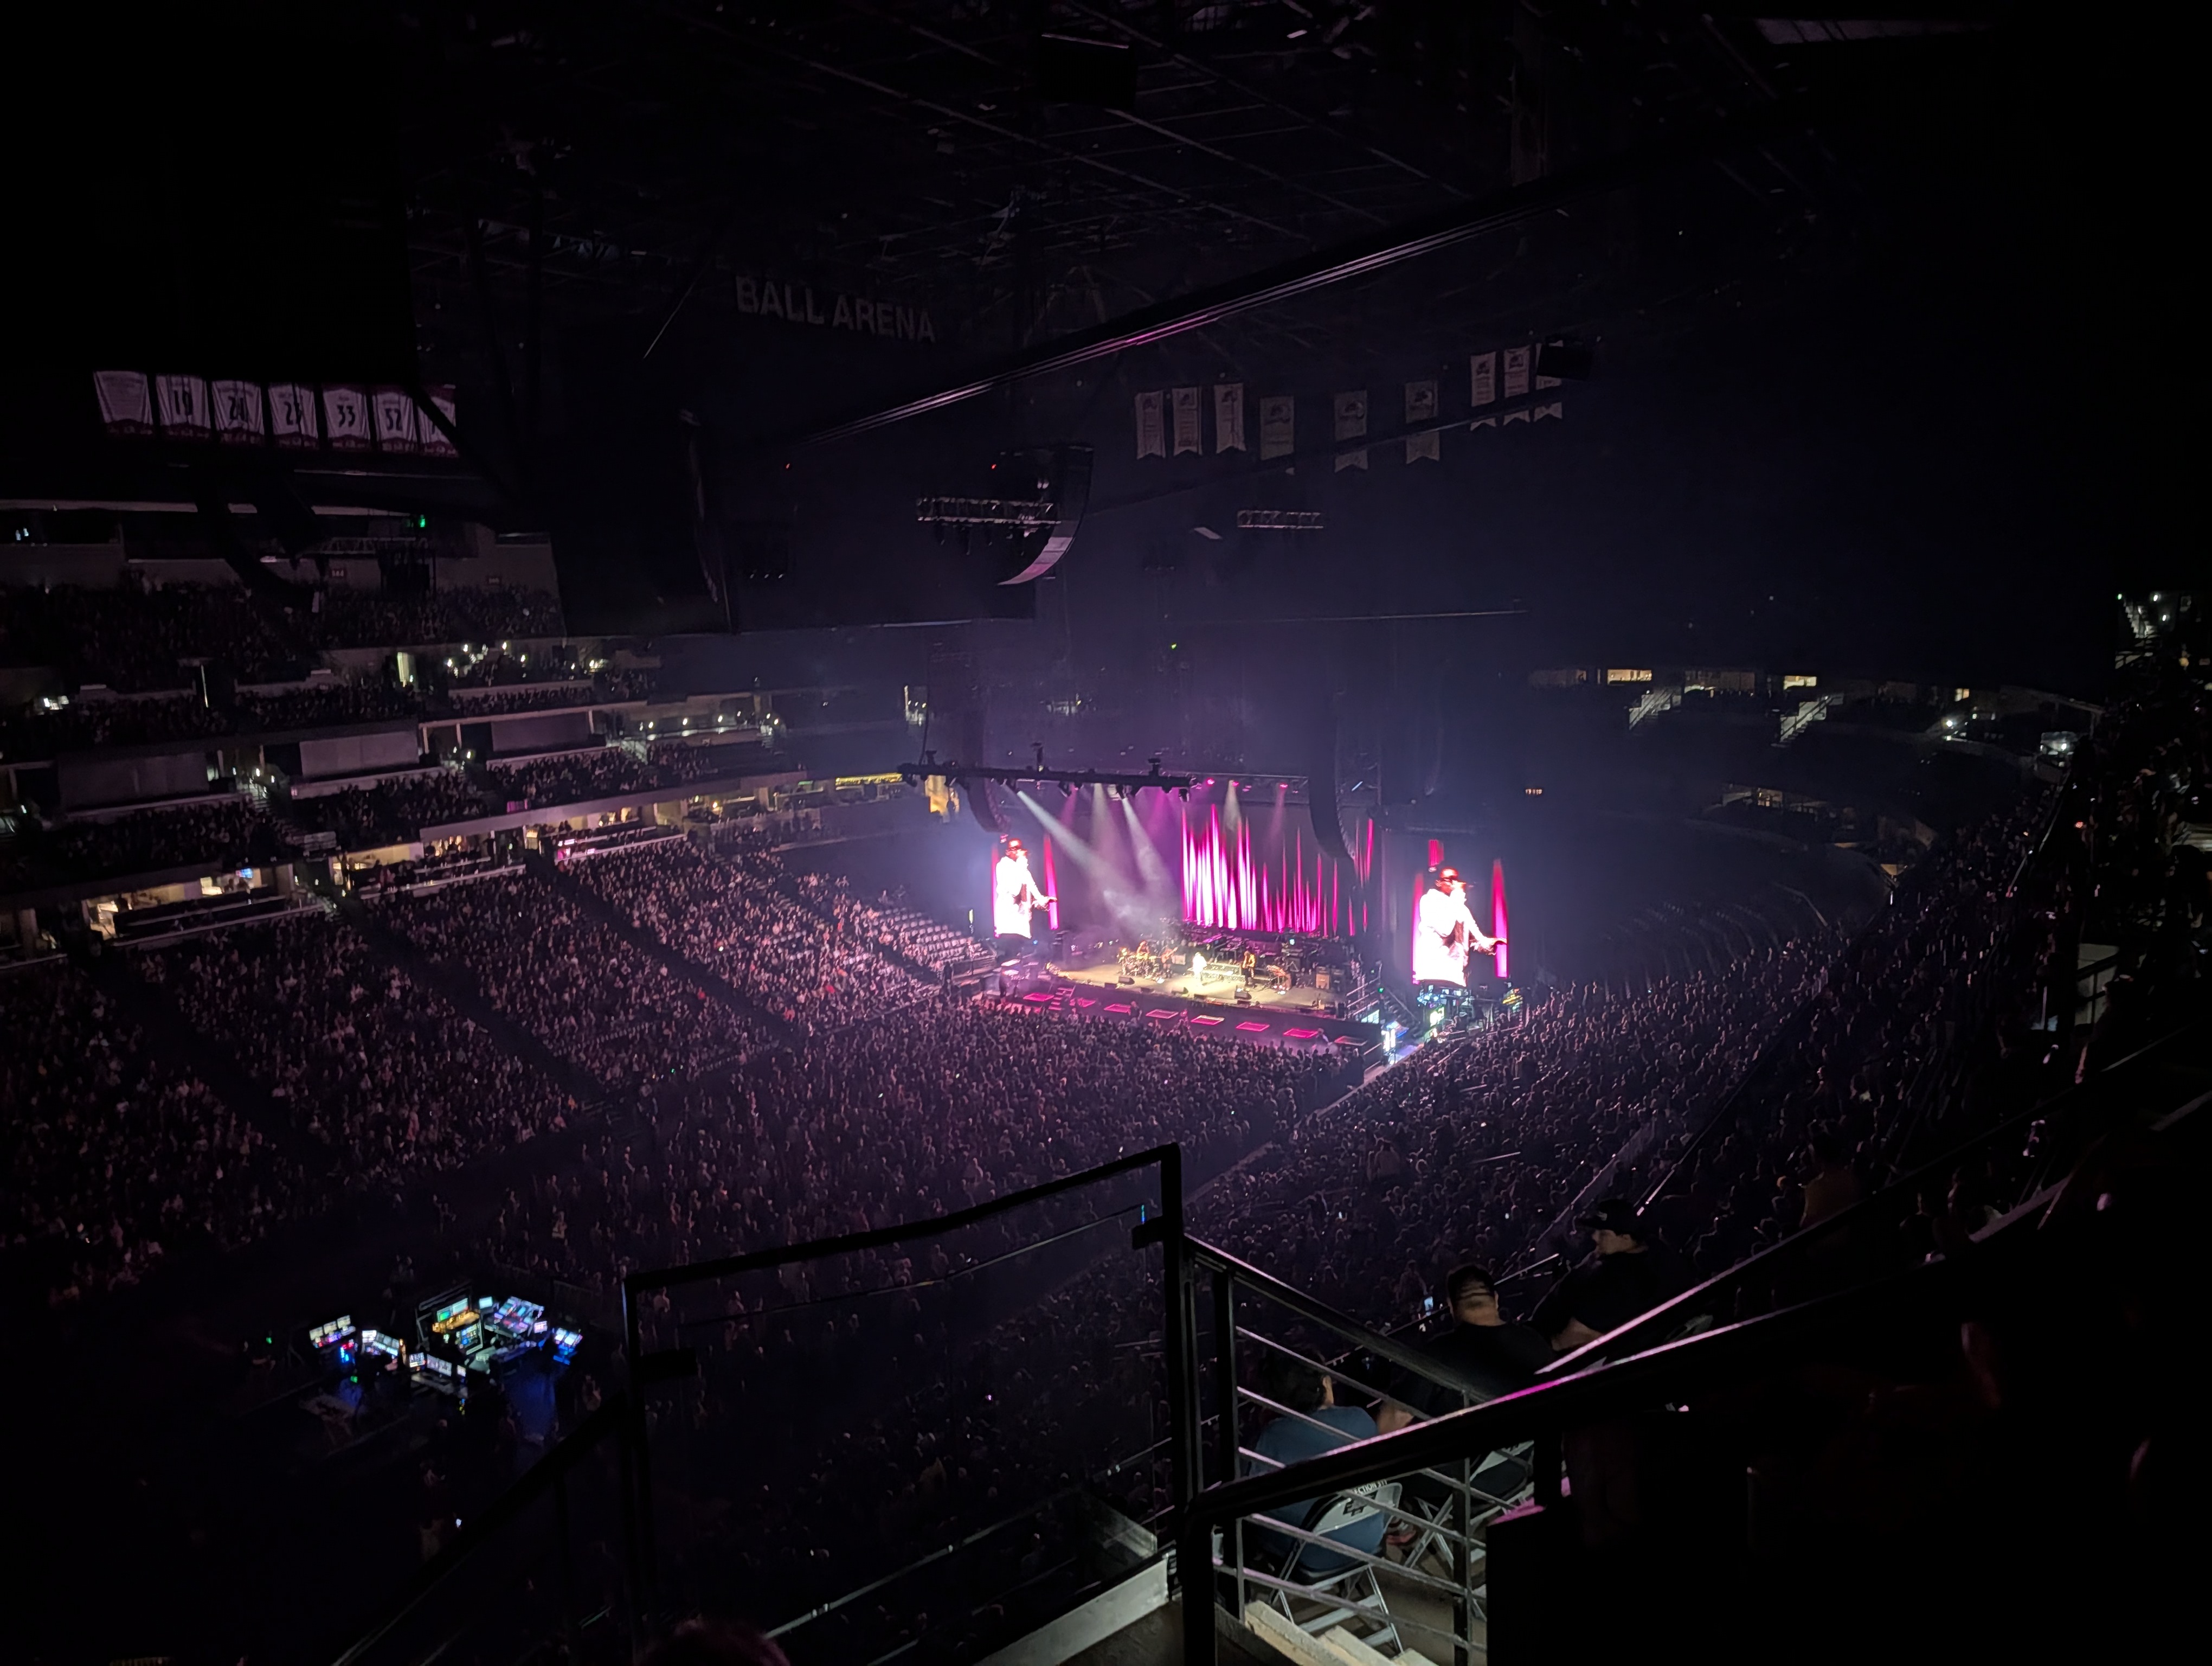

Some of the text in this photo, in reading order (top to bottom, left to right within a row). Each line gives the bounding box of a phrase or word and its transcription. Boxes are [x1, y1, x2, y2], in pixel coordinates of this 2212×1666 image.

[735, 275, 936, 343] BALL ARENA
[337, 404, 356, 428] 33
[384, 407, 402, 431] 52
